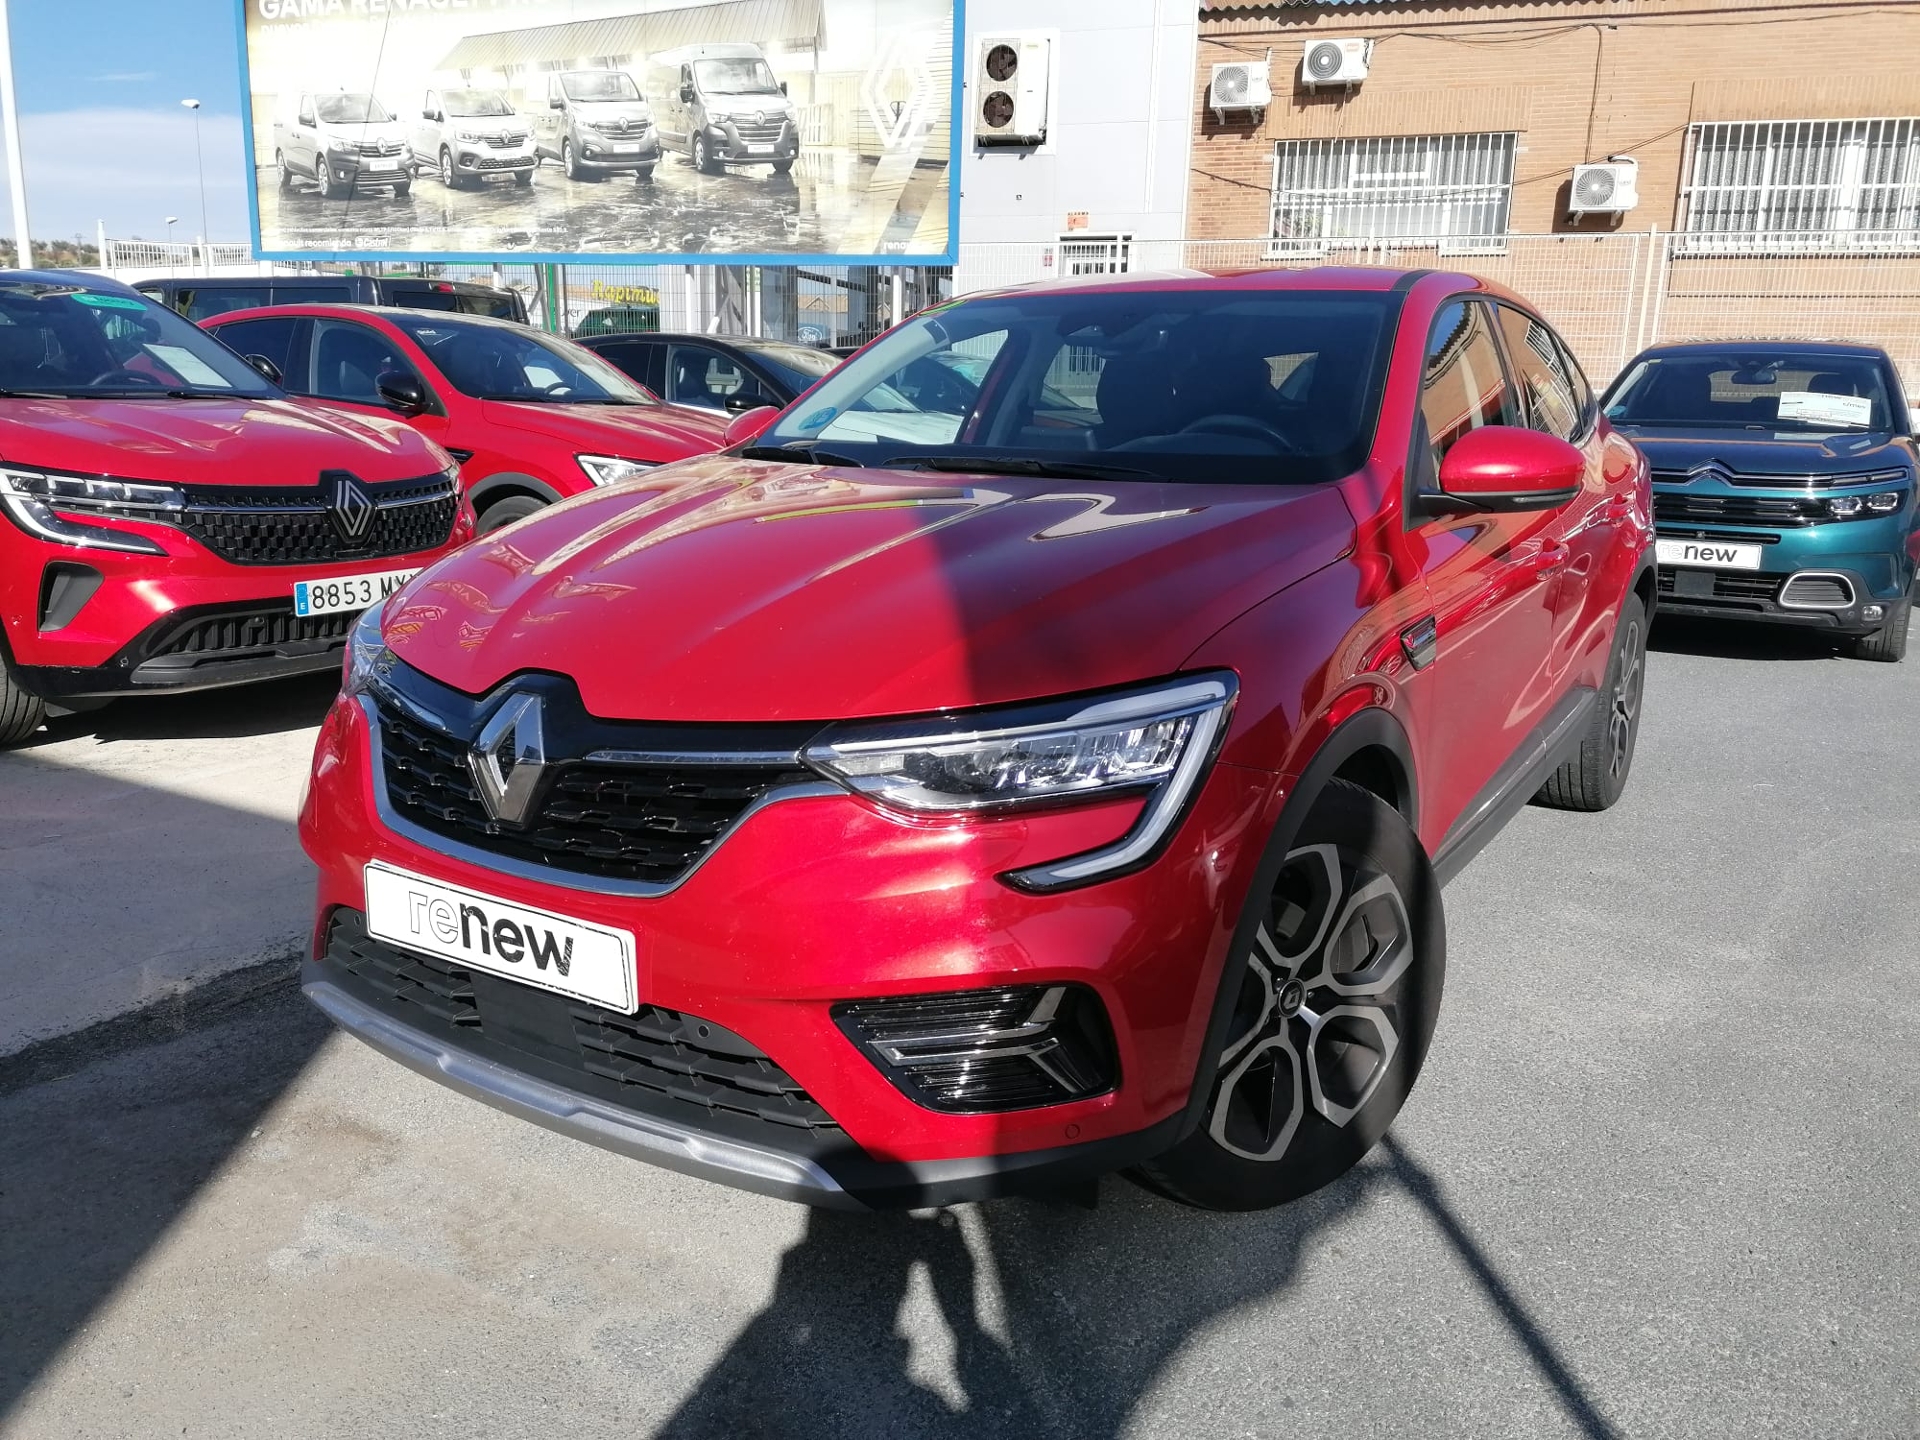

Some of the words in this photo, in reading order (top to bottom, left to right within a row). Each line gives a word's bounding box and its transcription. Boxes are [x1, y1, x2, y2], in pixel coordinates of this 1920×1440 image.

[258, 0, 347, 20] GAMA
[1658, 544, 1738, 562] renew
[312, 580, 372, 609] 8853
[408, 890, 574, 977] renew
